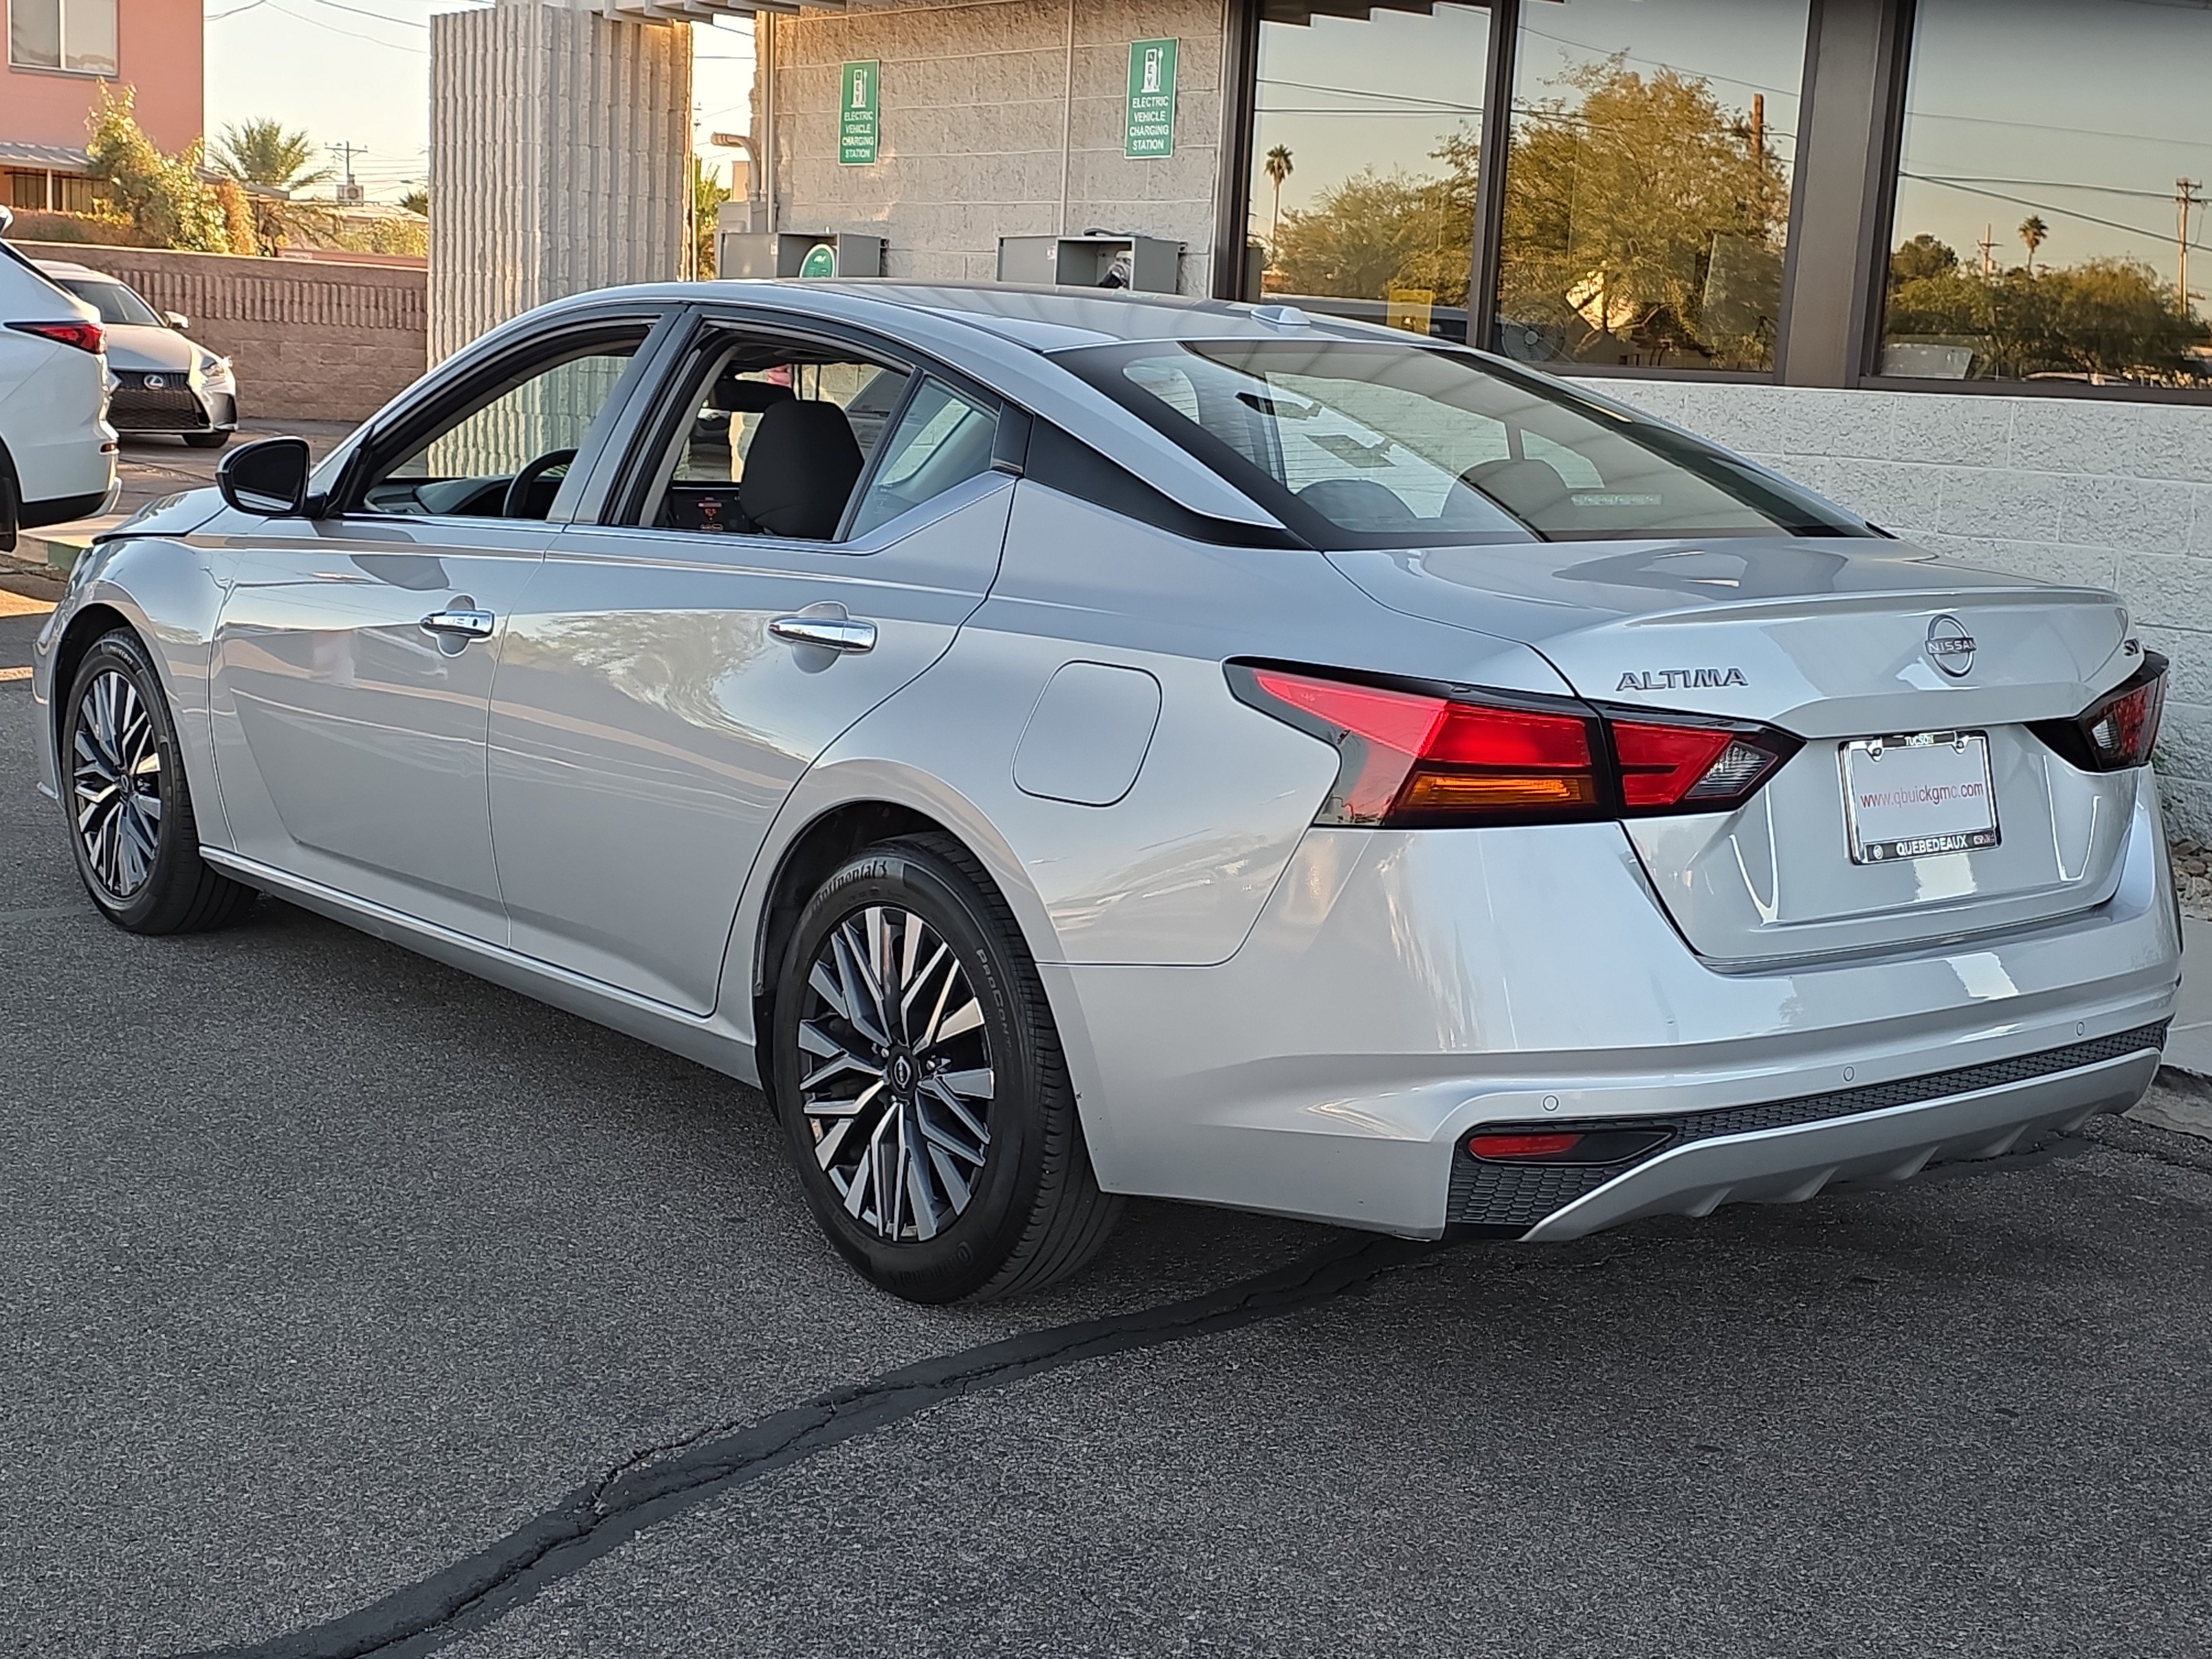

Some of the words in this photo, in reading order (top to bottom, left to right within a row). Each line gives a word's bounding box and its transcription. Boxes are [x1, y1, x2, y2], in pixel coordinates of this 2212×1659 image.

[1132, 95, 1169, 108] ELECTRIC
[844, 111, 873, 121] ELECTRIC
[1134, 111, 1166, 123] VEHICLE
[845, 124, 871, 134] VEHICLE
[1129, 125, 1169, 137] CHARGING
[842, 136, 874, 146] CHARGING
[1132, 139, 1164, 151] STATION
[845, 149, 871, 158] STATION
[1928, 640, 1976, 652] NISSAN
[1615, 668, 1749, 692] ALTIMA
[1904, 734, 1934, 746] TUCSON
[1860, 782, 1984, 809] www.qbuickgmc.com
[1896, 834, 1969, 857] QUEBEDEAUX
